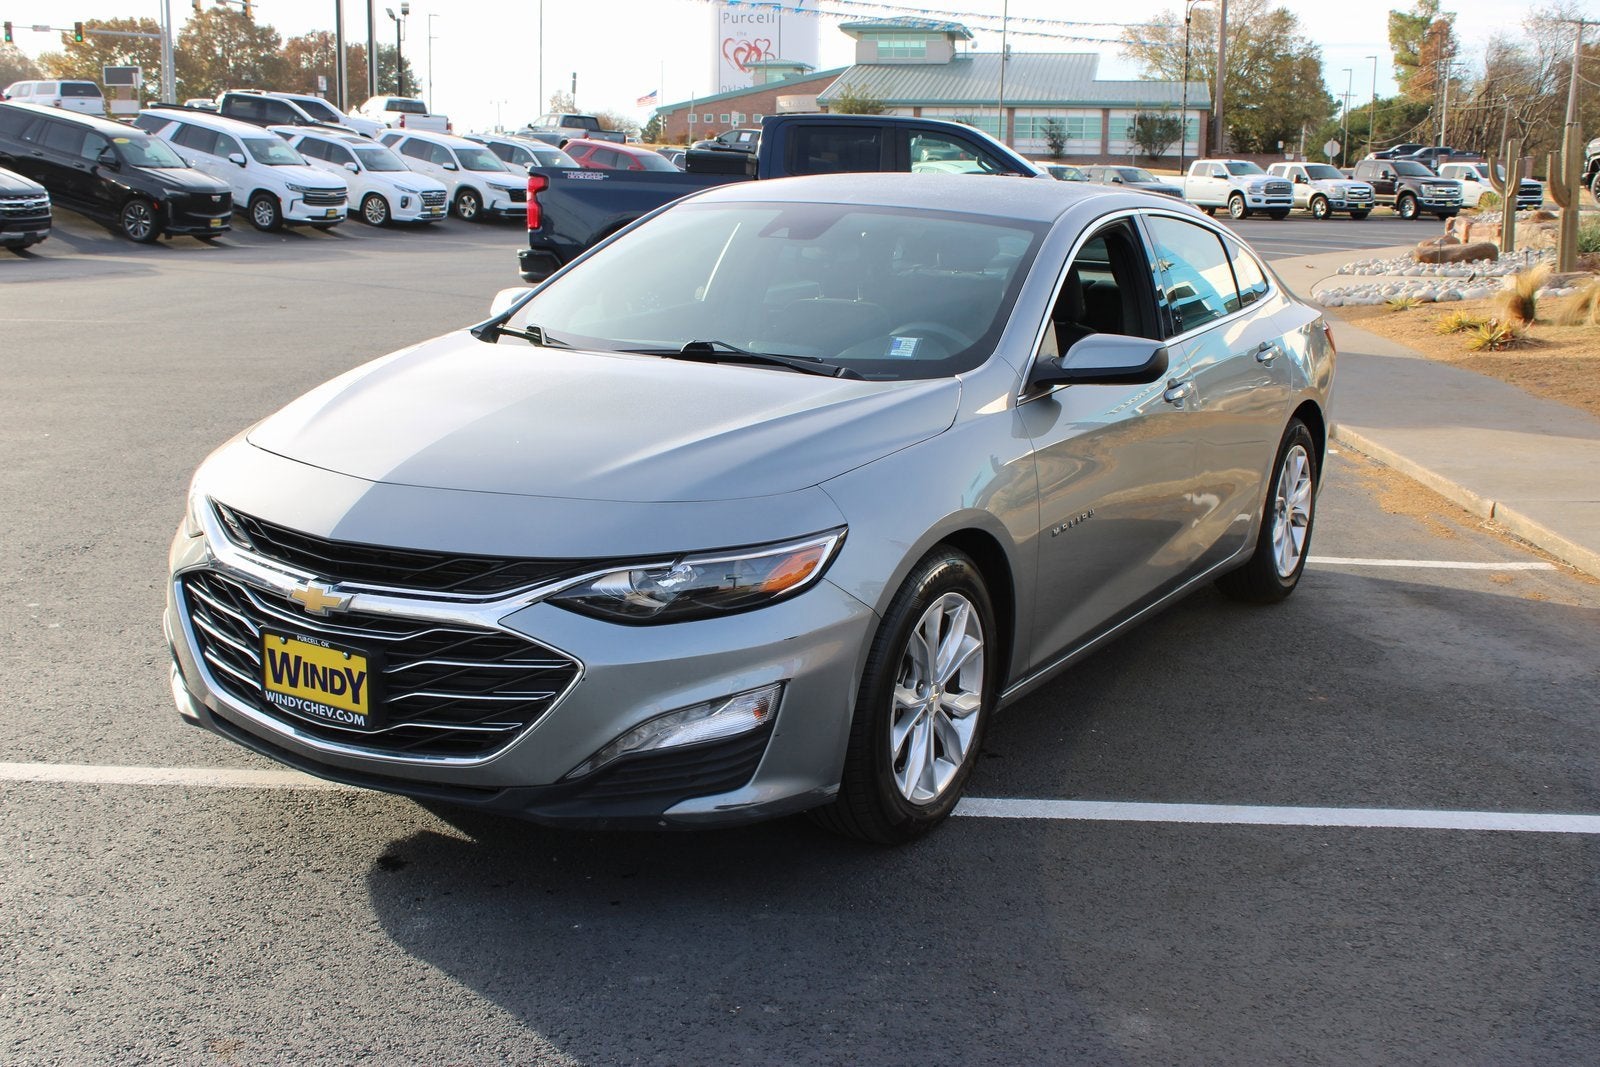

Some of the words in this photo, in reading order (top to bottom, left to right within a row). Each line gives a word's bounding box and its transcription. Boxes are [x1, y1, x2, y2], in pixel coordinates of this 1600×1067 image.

[723, 13, 775, 24] Purcell
[267, 648, 366, 705] WINDY
[265, 690, 365, 727] WINDYCHEV.COM
